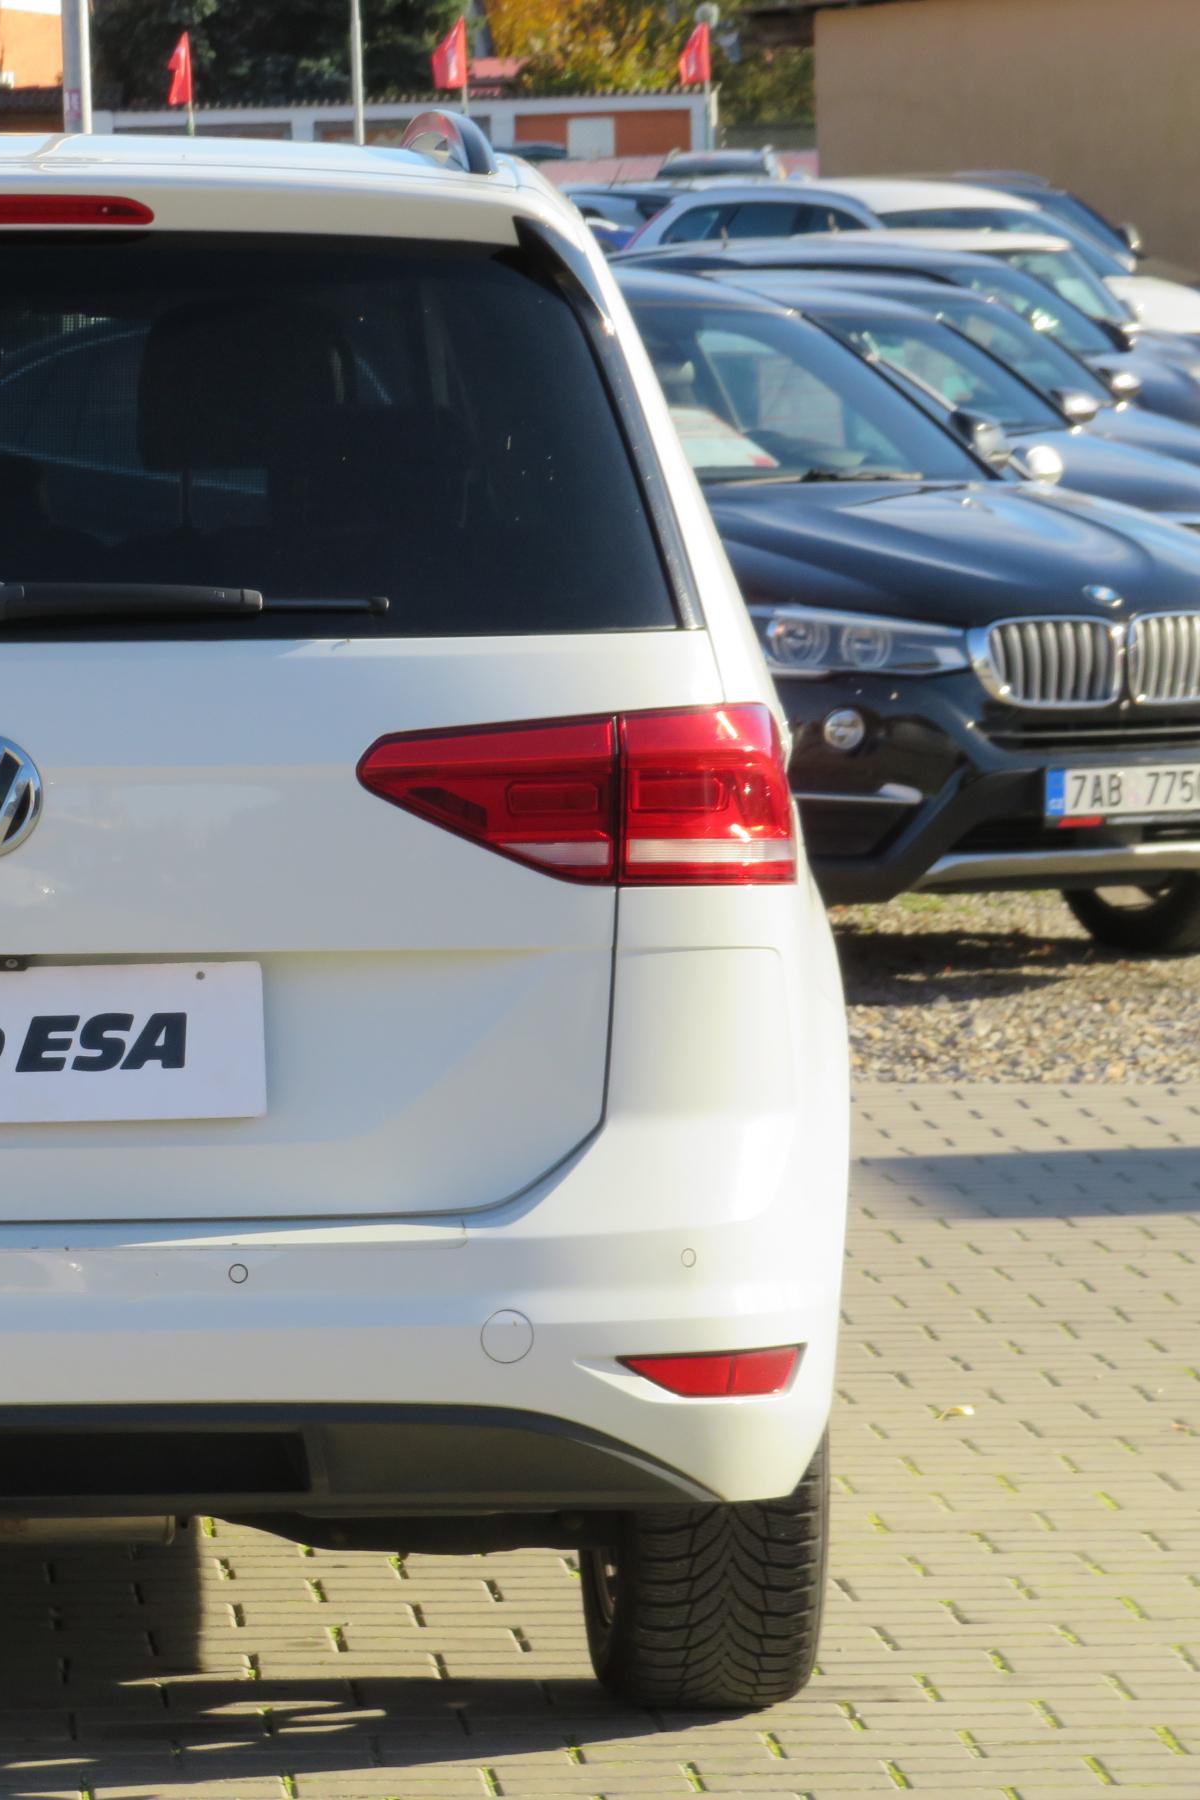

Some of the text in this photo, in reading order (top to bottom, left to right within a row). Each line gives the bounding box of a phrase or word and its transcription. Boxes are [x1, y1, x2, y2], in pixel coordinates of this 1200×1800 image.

[1071, 769, 1200, 809] 7AB 775
[14, 1012, 188, 1073] ESA
